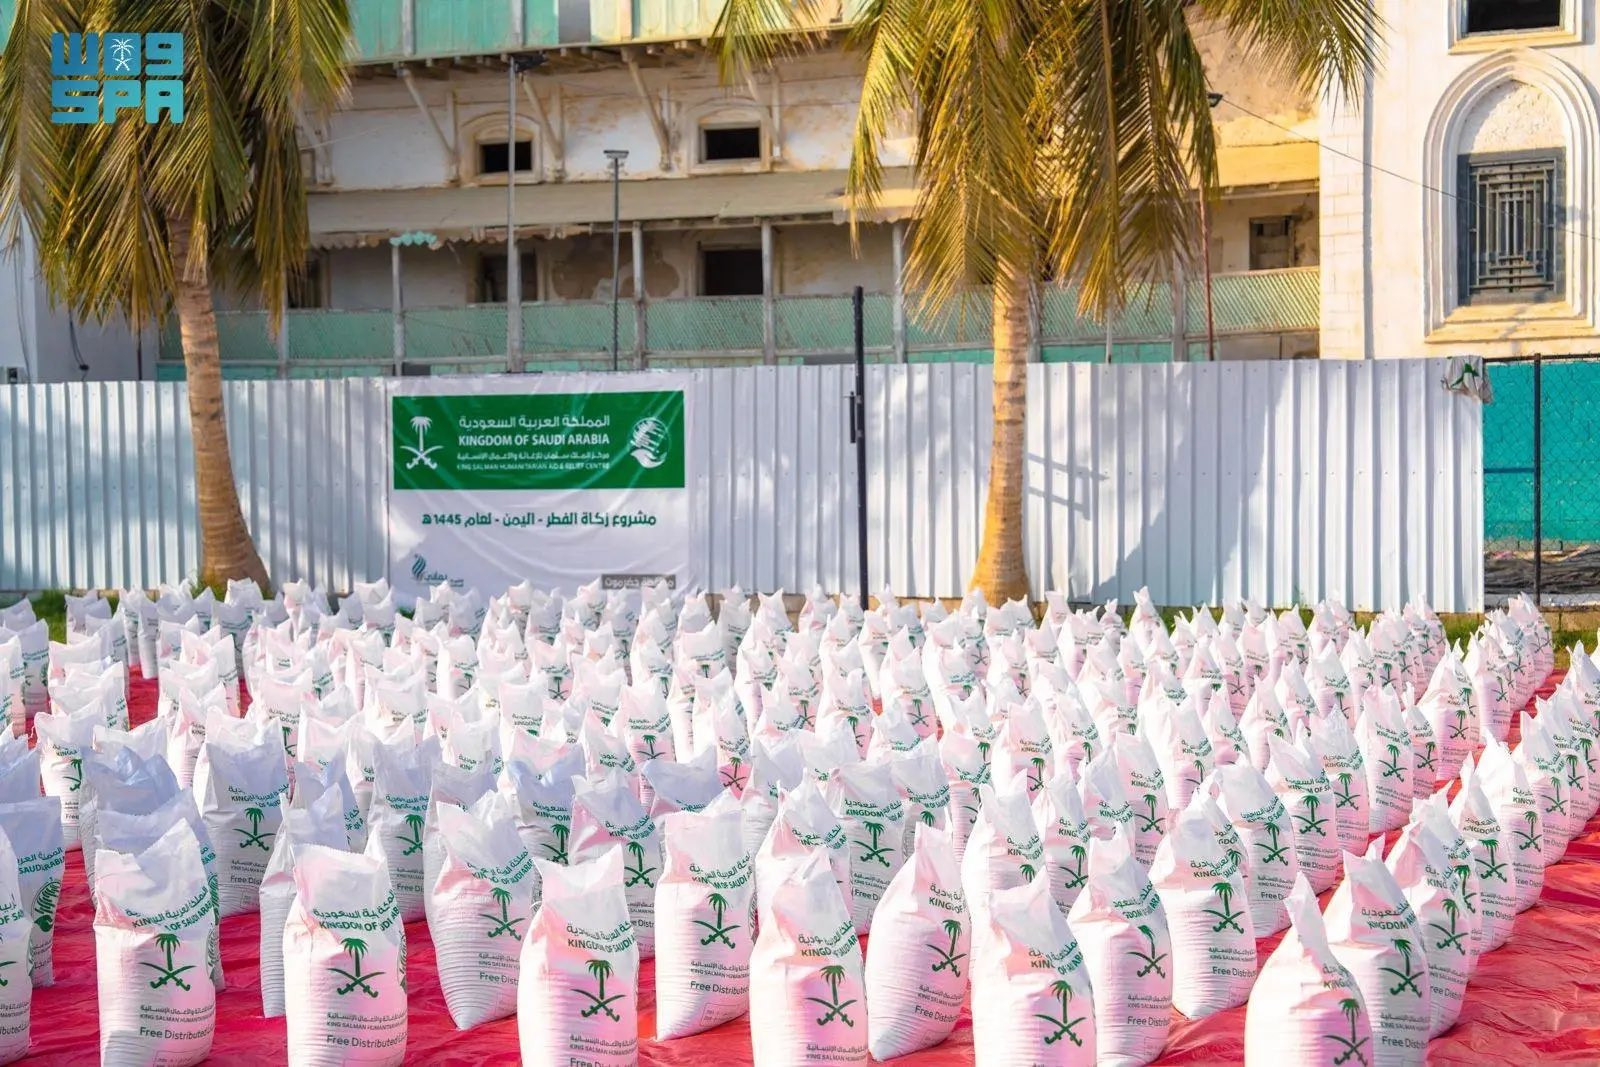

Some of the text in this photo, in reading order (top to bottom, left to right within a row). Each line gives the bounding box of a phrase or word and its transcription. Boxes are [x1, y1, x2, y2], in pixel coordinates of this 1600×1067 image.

[458, 415, 610, 431] المملكة العربية السعودية
[458, 433, 610, 446] KINGDOM OF SAUDI ARABIA
[434, 512, 461, 525] 1445
[464, 512, 492, 527] لعام
[502, 512, 535, 527] اليمن
[546, 512, 578, 527] الفطر
[581, 512, 609, 526] زكاة
[612, 510, 657, 527] مشروع
[230, 876, 247, 884] Free
[397, 883, 414, 892] Free
[854, 889, 872, 898] Free
[319, 920, 379, 932] KINGDOM OF
[801, 947, 832, 957] KINGD
[480, 972, 500, 981] Free
[1212, 966, 1231, 976] Free
[690, 980, 711, 992] Free
[915, 1005, 934, 1018] Free
[1127, 1015, 1147, 1026] Free
[139, 1026, 163, 1038] Free
[327, 1035, 398, 1048] Free Distributed
[1382, 1036, 1406, 1047] Free
[570, 1057, 592, 1067] Free
